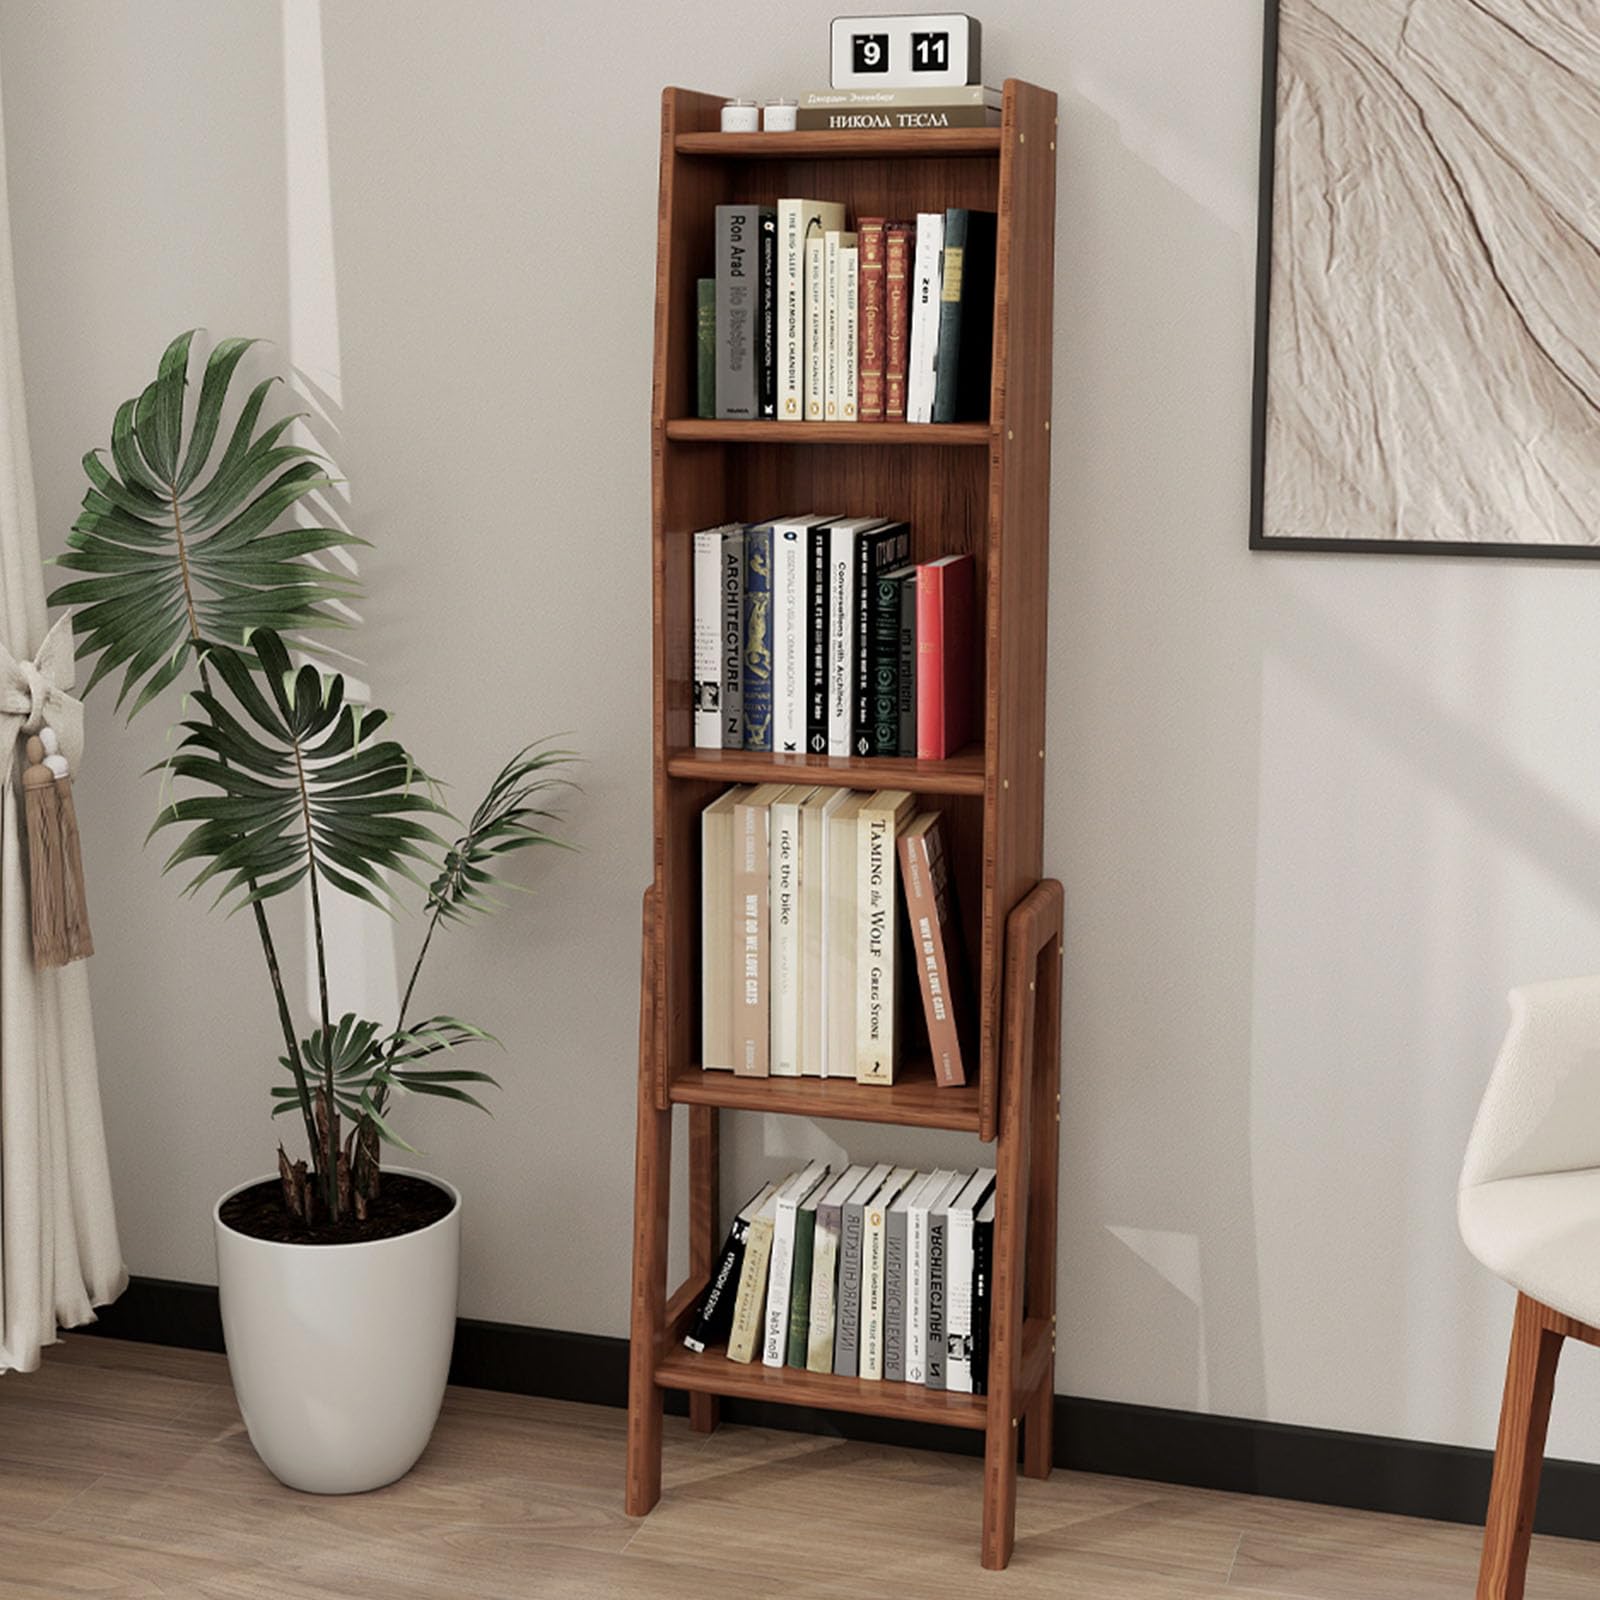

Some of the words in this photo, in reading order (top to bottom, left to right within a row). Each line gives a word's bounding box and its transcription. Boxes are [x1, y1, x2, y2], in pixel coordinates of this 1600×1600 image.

[863, 41, 881, 65] 9
[916, 39, 945, 64] 11
[829, 114, 892, 128] НИКОЛА
[896, 113, 949, 127] ТЕСЛА
[730, 215, 746, 242] Ron
[788, 213, 796, 229] THE
[788, 232, 796, 249] BIG
[730, 246, 746, 277] Arad
[788, 252, 796, 278] SLEEP
[922, 277, 930, 304] zen
[788, 291, 796, 338] RAYMOND
[788, 342, 796, 390] CHANDLER
[838, 561, 847, 637] Conversations
[727, 553, 739, 693] ARCHITECTURE
[837, 639, 845, 662] with
[836, 665, 844, 717] Architects
[780, 829, 792, 860] ride
[870, 819, 886, 885] TAMING
[780, 864, 792, 888] the
[745, 895, 758, 917] WHY
[780, 893, 792, 925] bike
[871, 890, 882, 907] the
[745, 919, 758, 934] DO
[870, 911, 886, 957] WOLF
[919, 917, 934, 938] WHY
[745, 936, 758, 951] WE
[923, 940, 937, 954] DO
[745, 953, 758, 977] LOVE
[926, 957, 939, 971] WE
[745, 979, 758, 1005] CATS
[870, 967, 882, 1000] GREG
[928, 972, 942, 995] LOVE
[871, 1003, 882, 1040] STONE
[931, 997, 945, 1020] CATS
